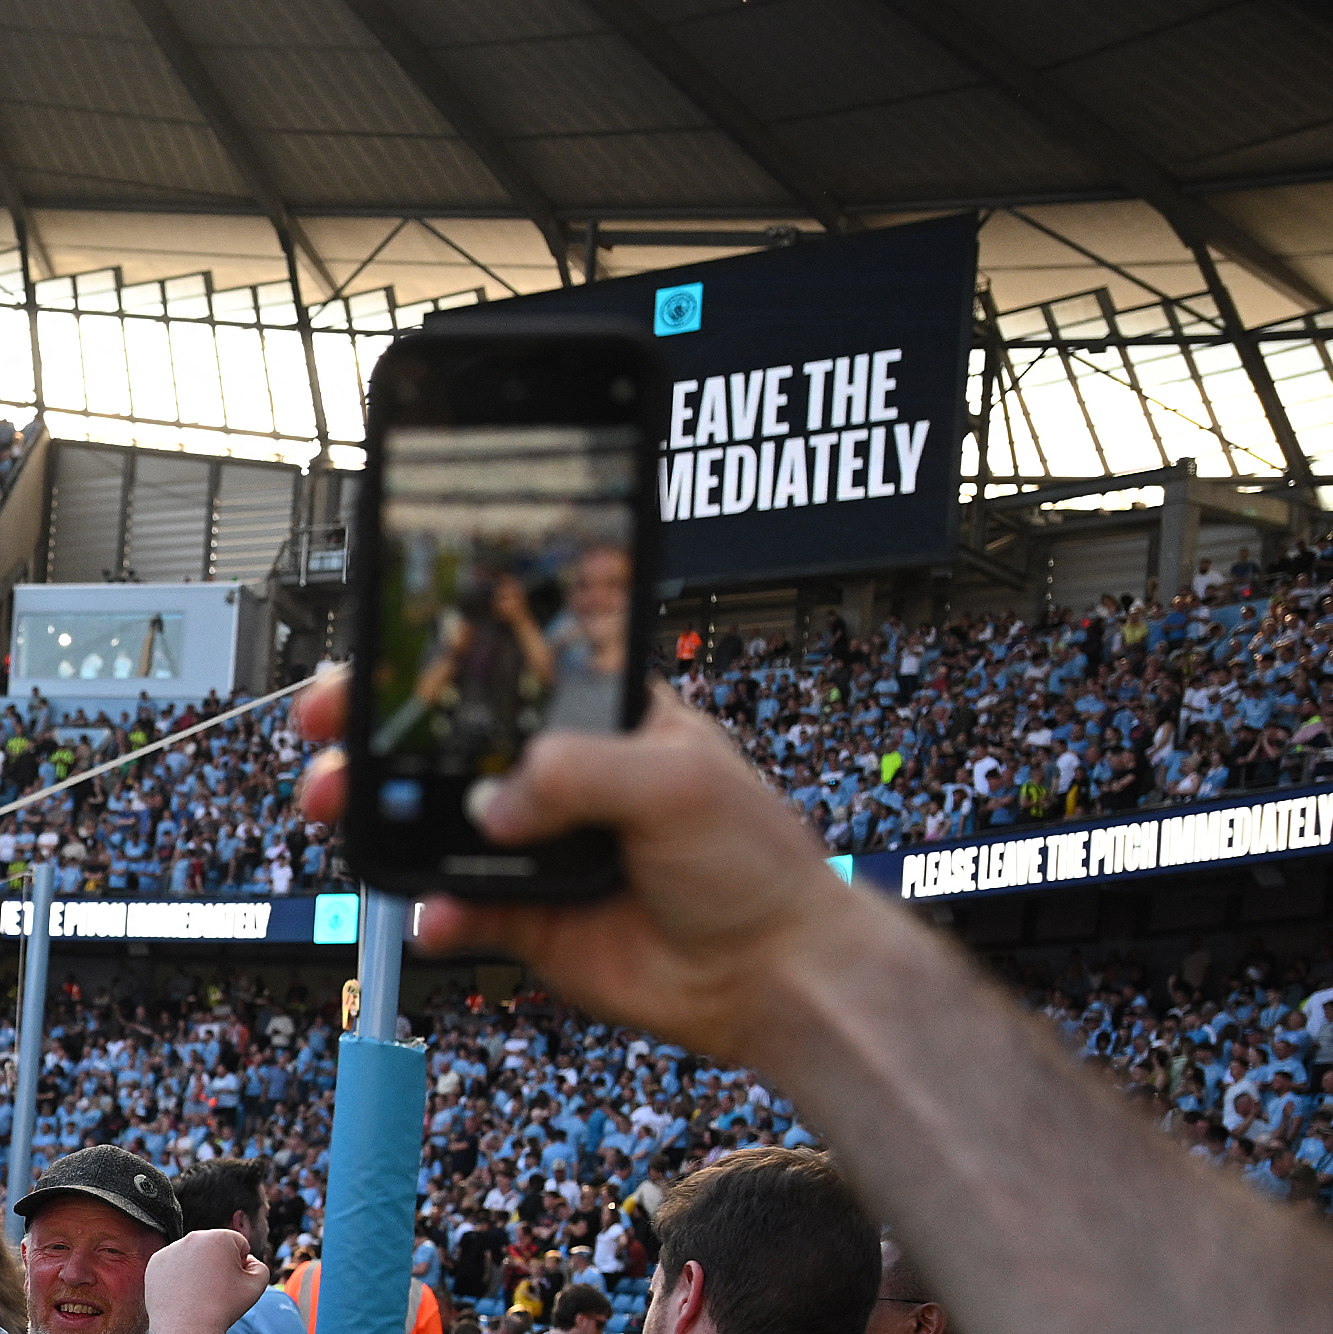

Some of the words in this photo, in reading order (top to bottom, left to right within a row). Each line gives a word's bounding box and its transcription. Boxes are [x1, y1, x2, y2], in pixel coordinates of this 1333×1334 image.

[659, 365, 793, 450] EAVE
[803, 348, 902, 432] THE
[901, 846, 978, 899] PLEASE
[977, 837, 1043, 890] LEAVE
[1045, 831, 1089, 881] THE
[1089, 820, 1161, 877] PITCH
[1159, 792, 1333, 868] IMMEDIATELY
